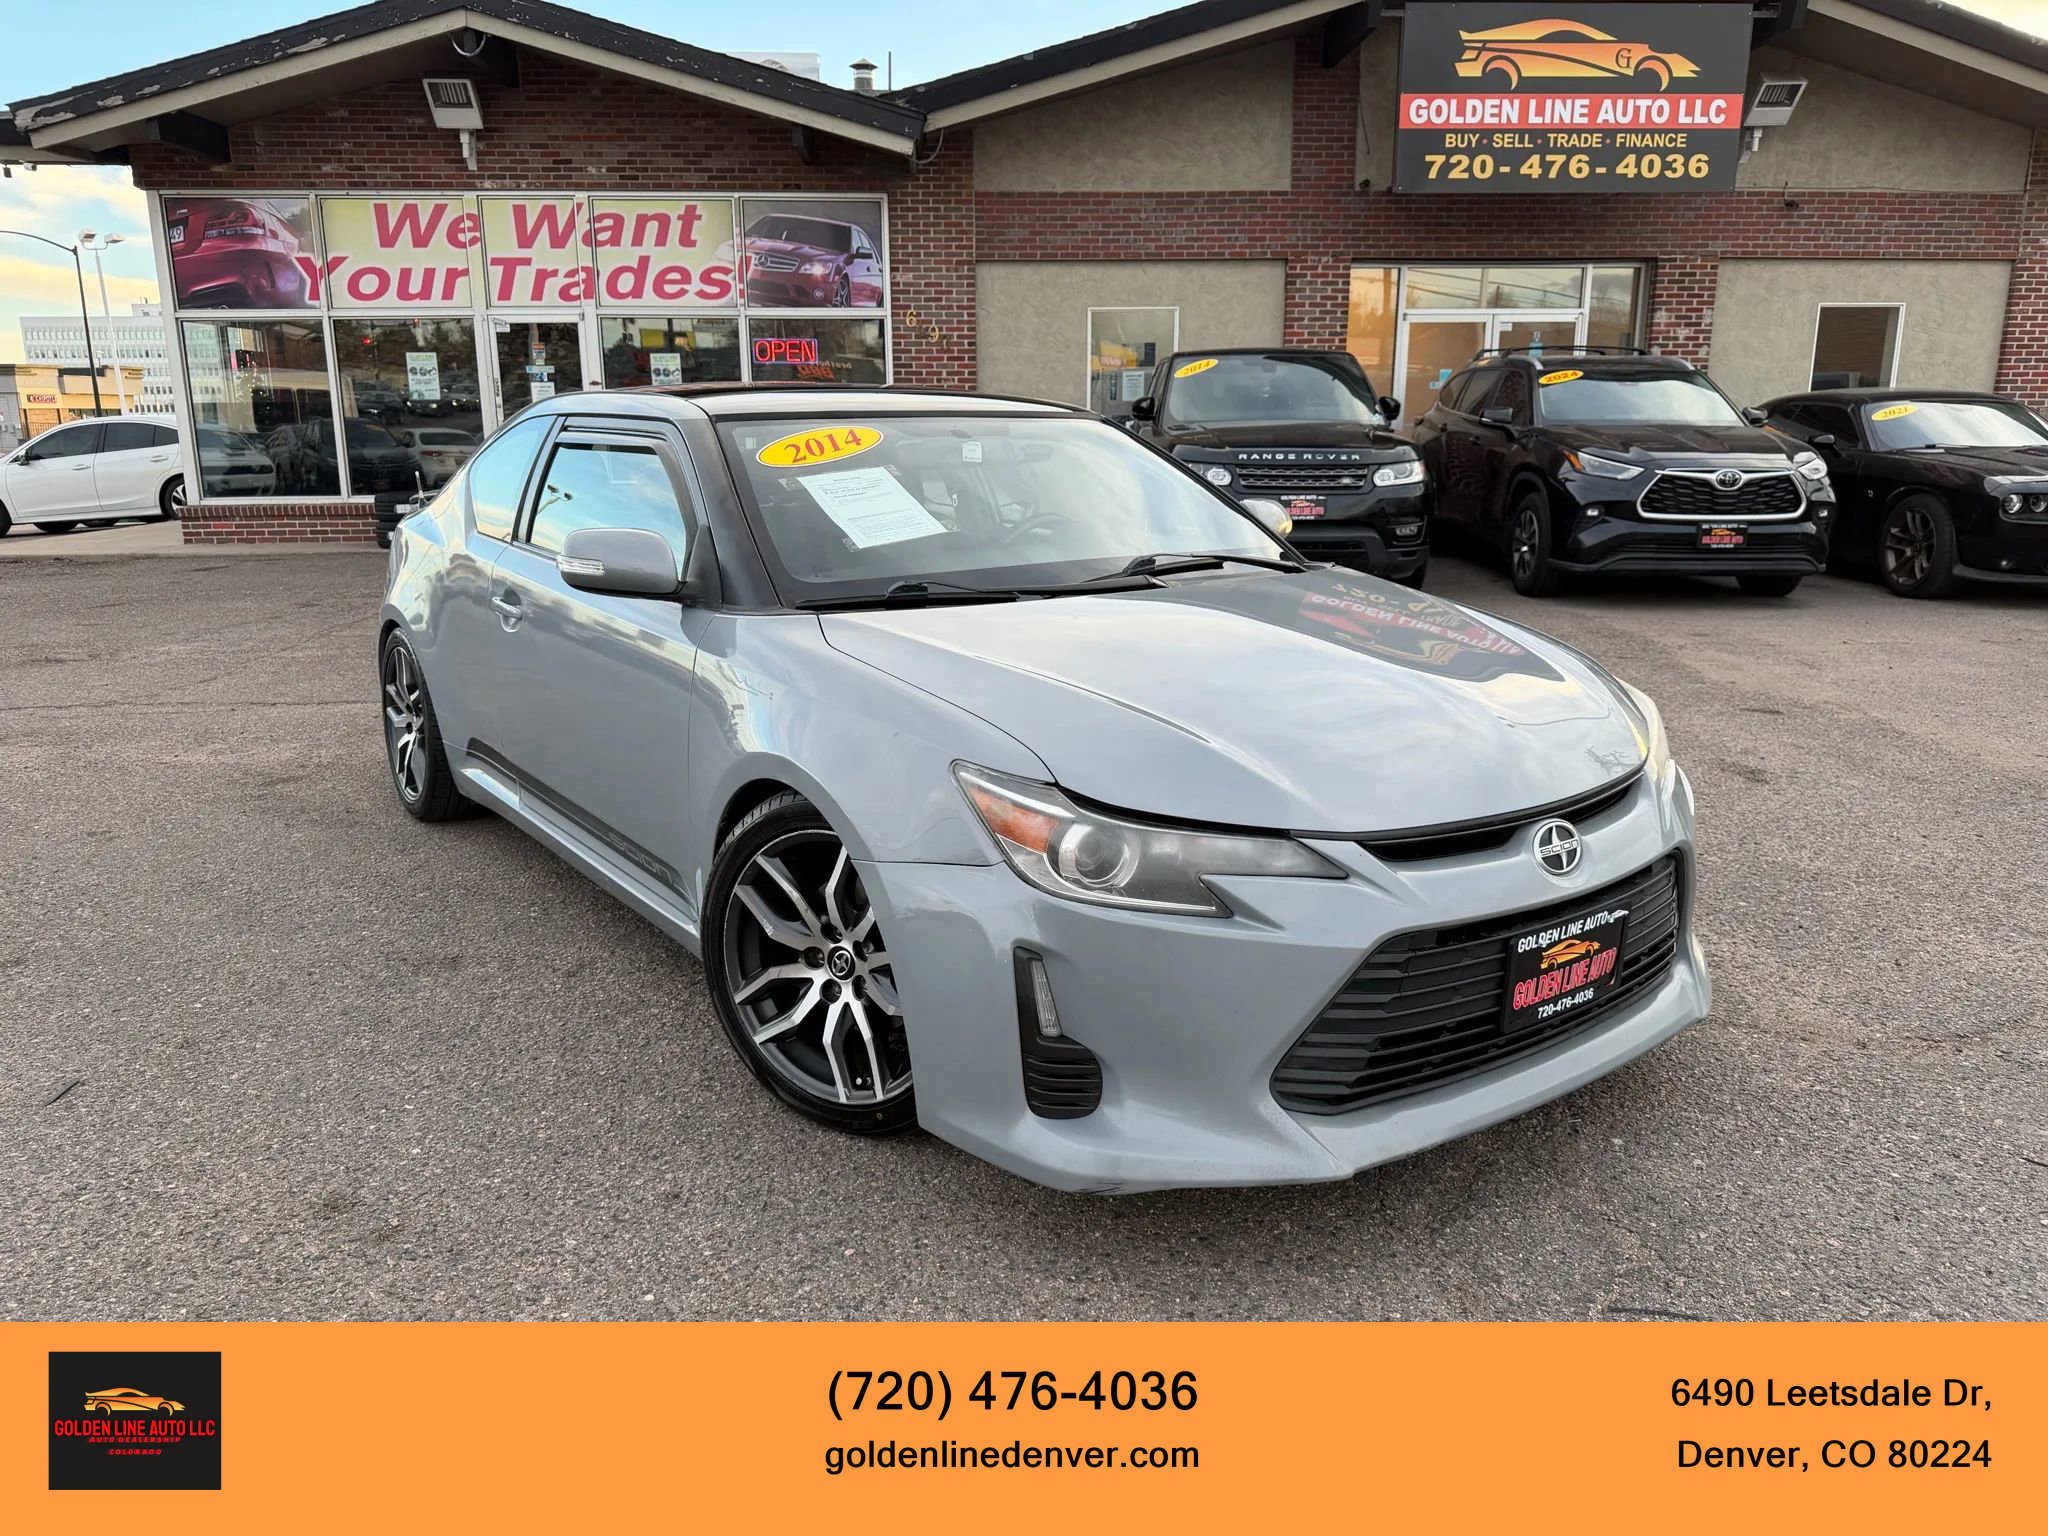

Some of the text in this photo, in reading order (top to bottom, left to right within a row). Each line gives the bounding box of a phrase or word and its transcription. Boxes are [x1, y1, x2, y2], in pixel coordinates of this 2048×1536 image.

[1409, 98, 1727, 124] GOLDEN LINE AUTO LLC
[1445, 133, 1687, 148] BUY SELL TRADE FINANCE
[373, 202, 703, 250] We Want
[294, 255, 753, 302] Your Trades!
[755, 340, 816, 362] OPEN
[784, 428, 862, 463] 2014
[1303, 453, 1360, 461] ROVER
[1518, 911, 1608, 953] GOLDEN LINE AUTO
[1512, 947, 1617, 1010] GOLDEN LINE AUTO
[1537, 988, 1594, 1019] 720-476-4036
